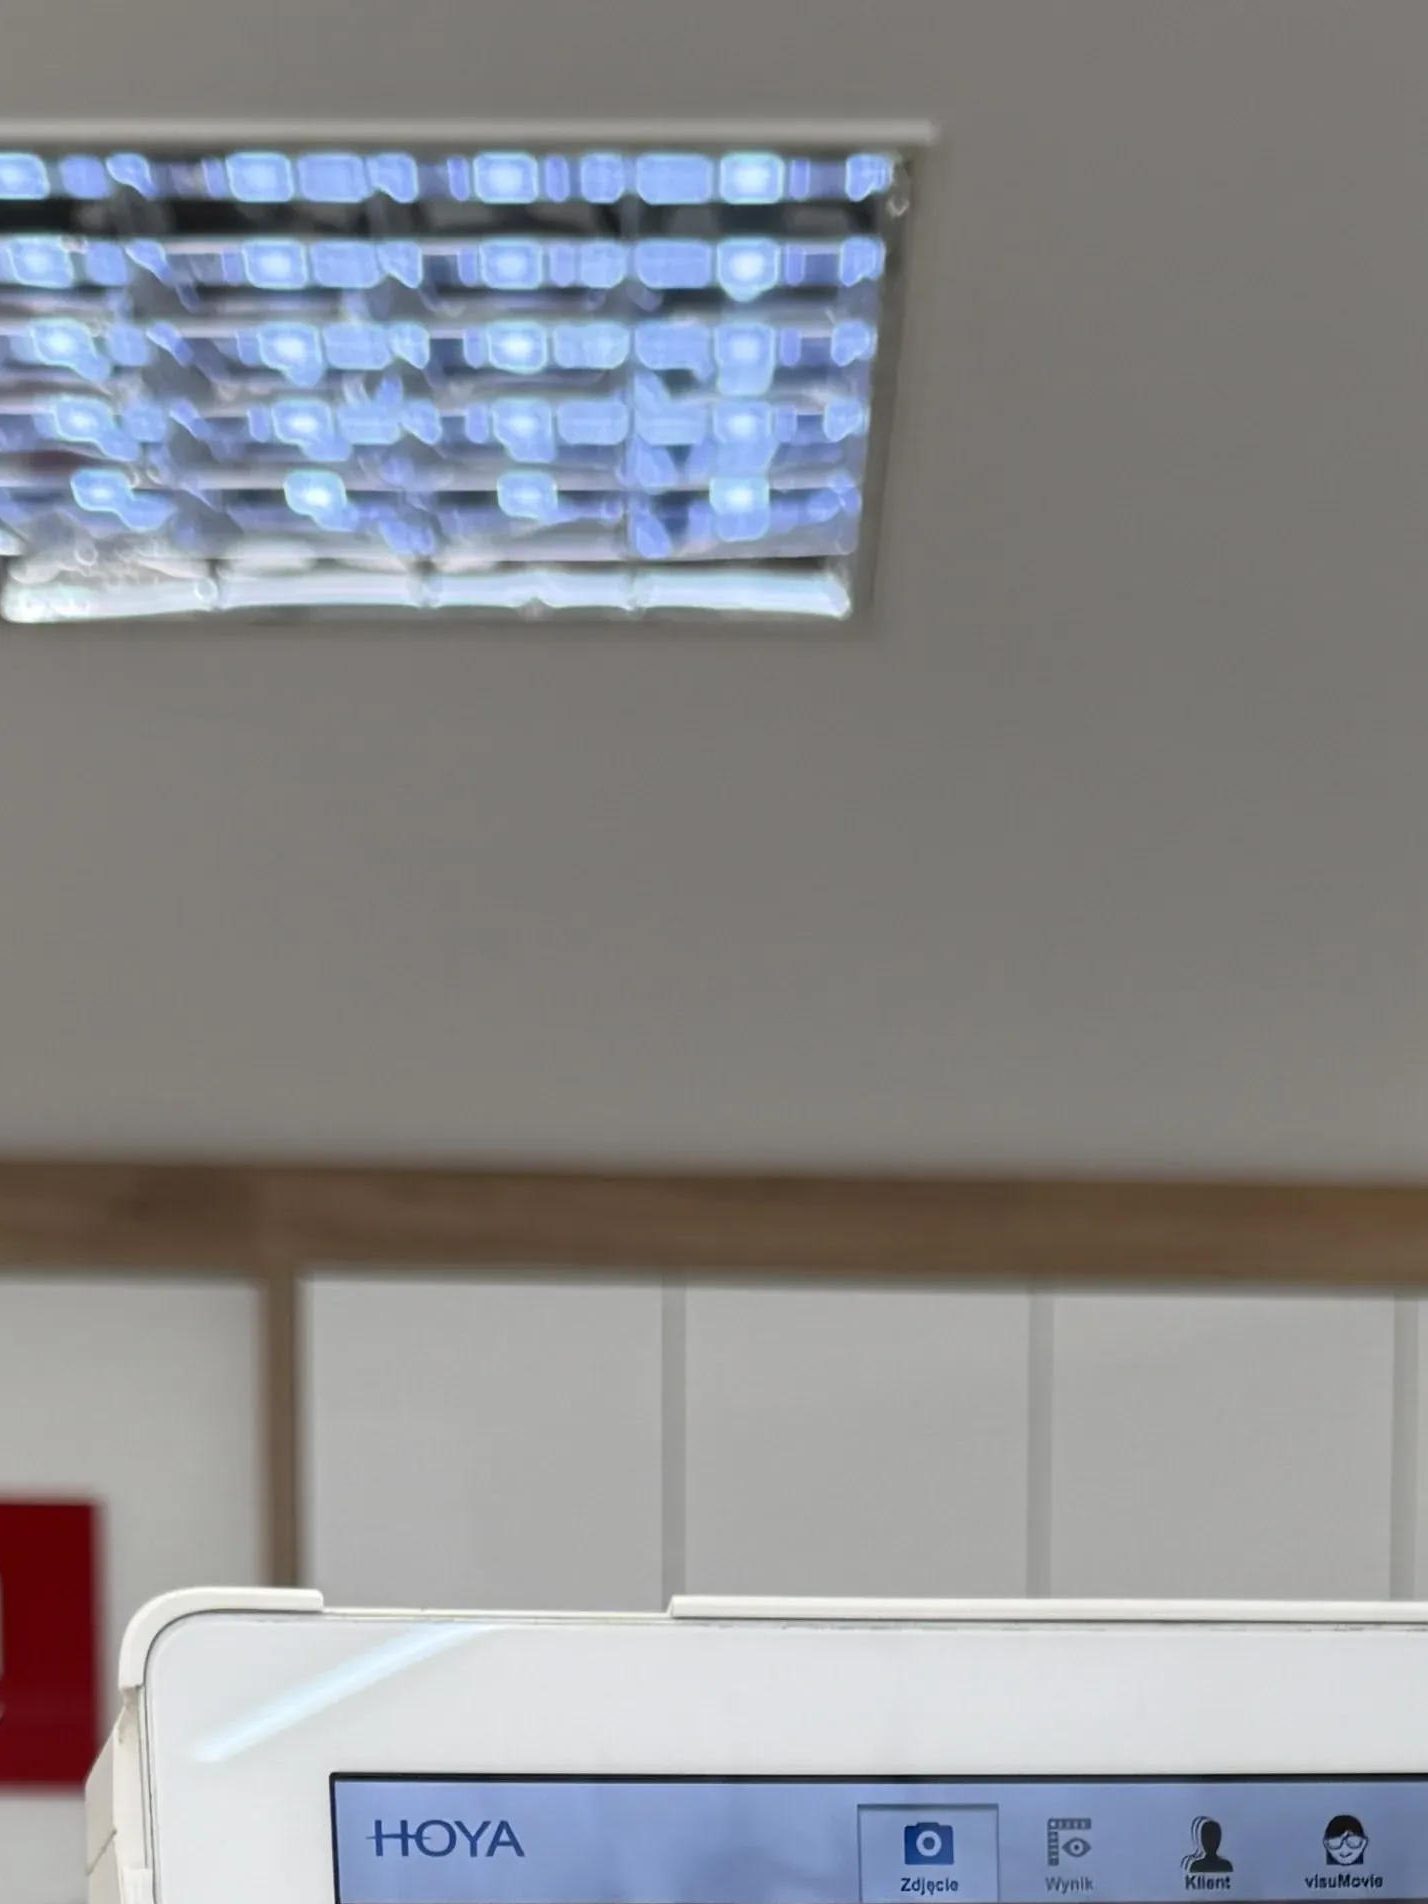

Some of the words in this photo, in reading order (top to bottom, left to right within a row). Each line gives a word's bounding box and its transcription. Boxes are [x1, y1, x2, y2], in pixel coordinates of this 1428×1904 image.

[366, 1819, 525, 1857] HOYA
[900, 1877, 959, 1895] Zdjęcie
[1045, 1876, 1094, 1894] Wynik
[1185, 1875, 1231, 1890] Klient
[1305, 1874, 1383, 1890] visuMovie
